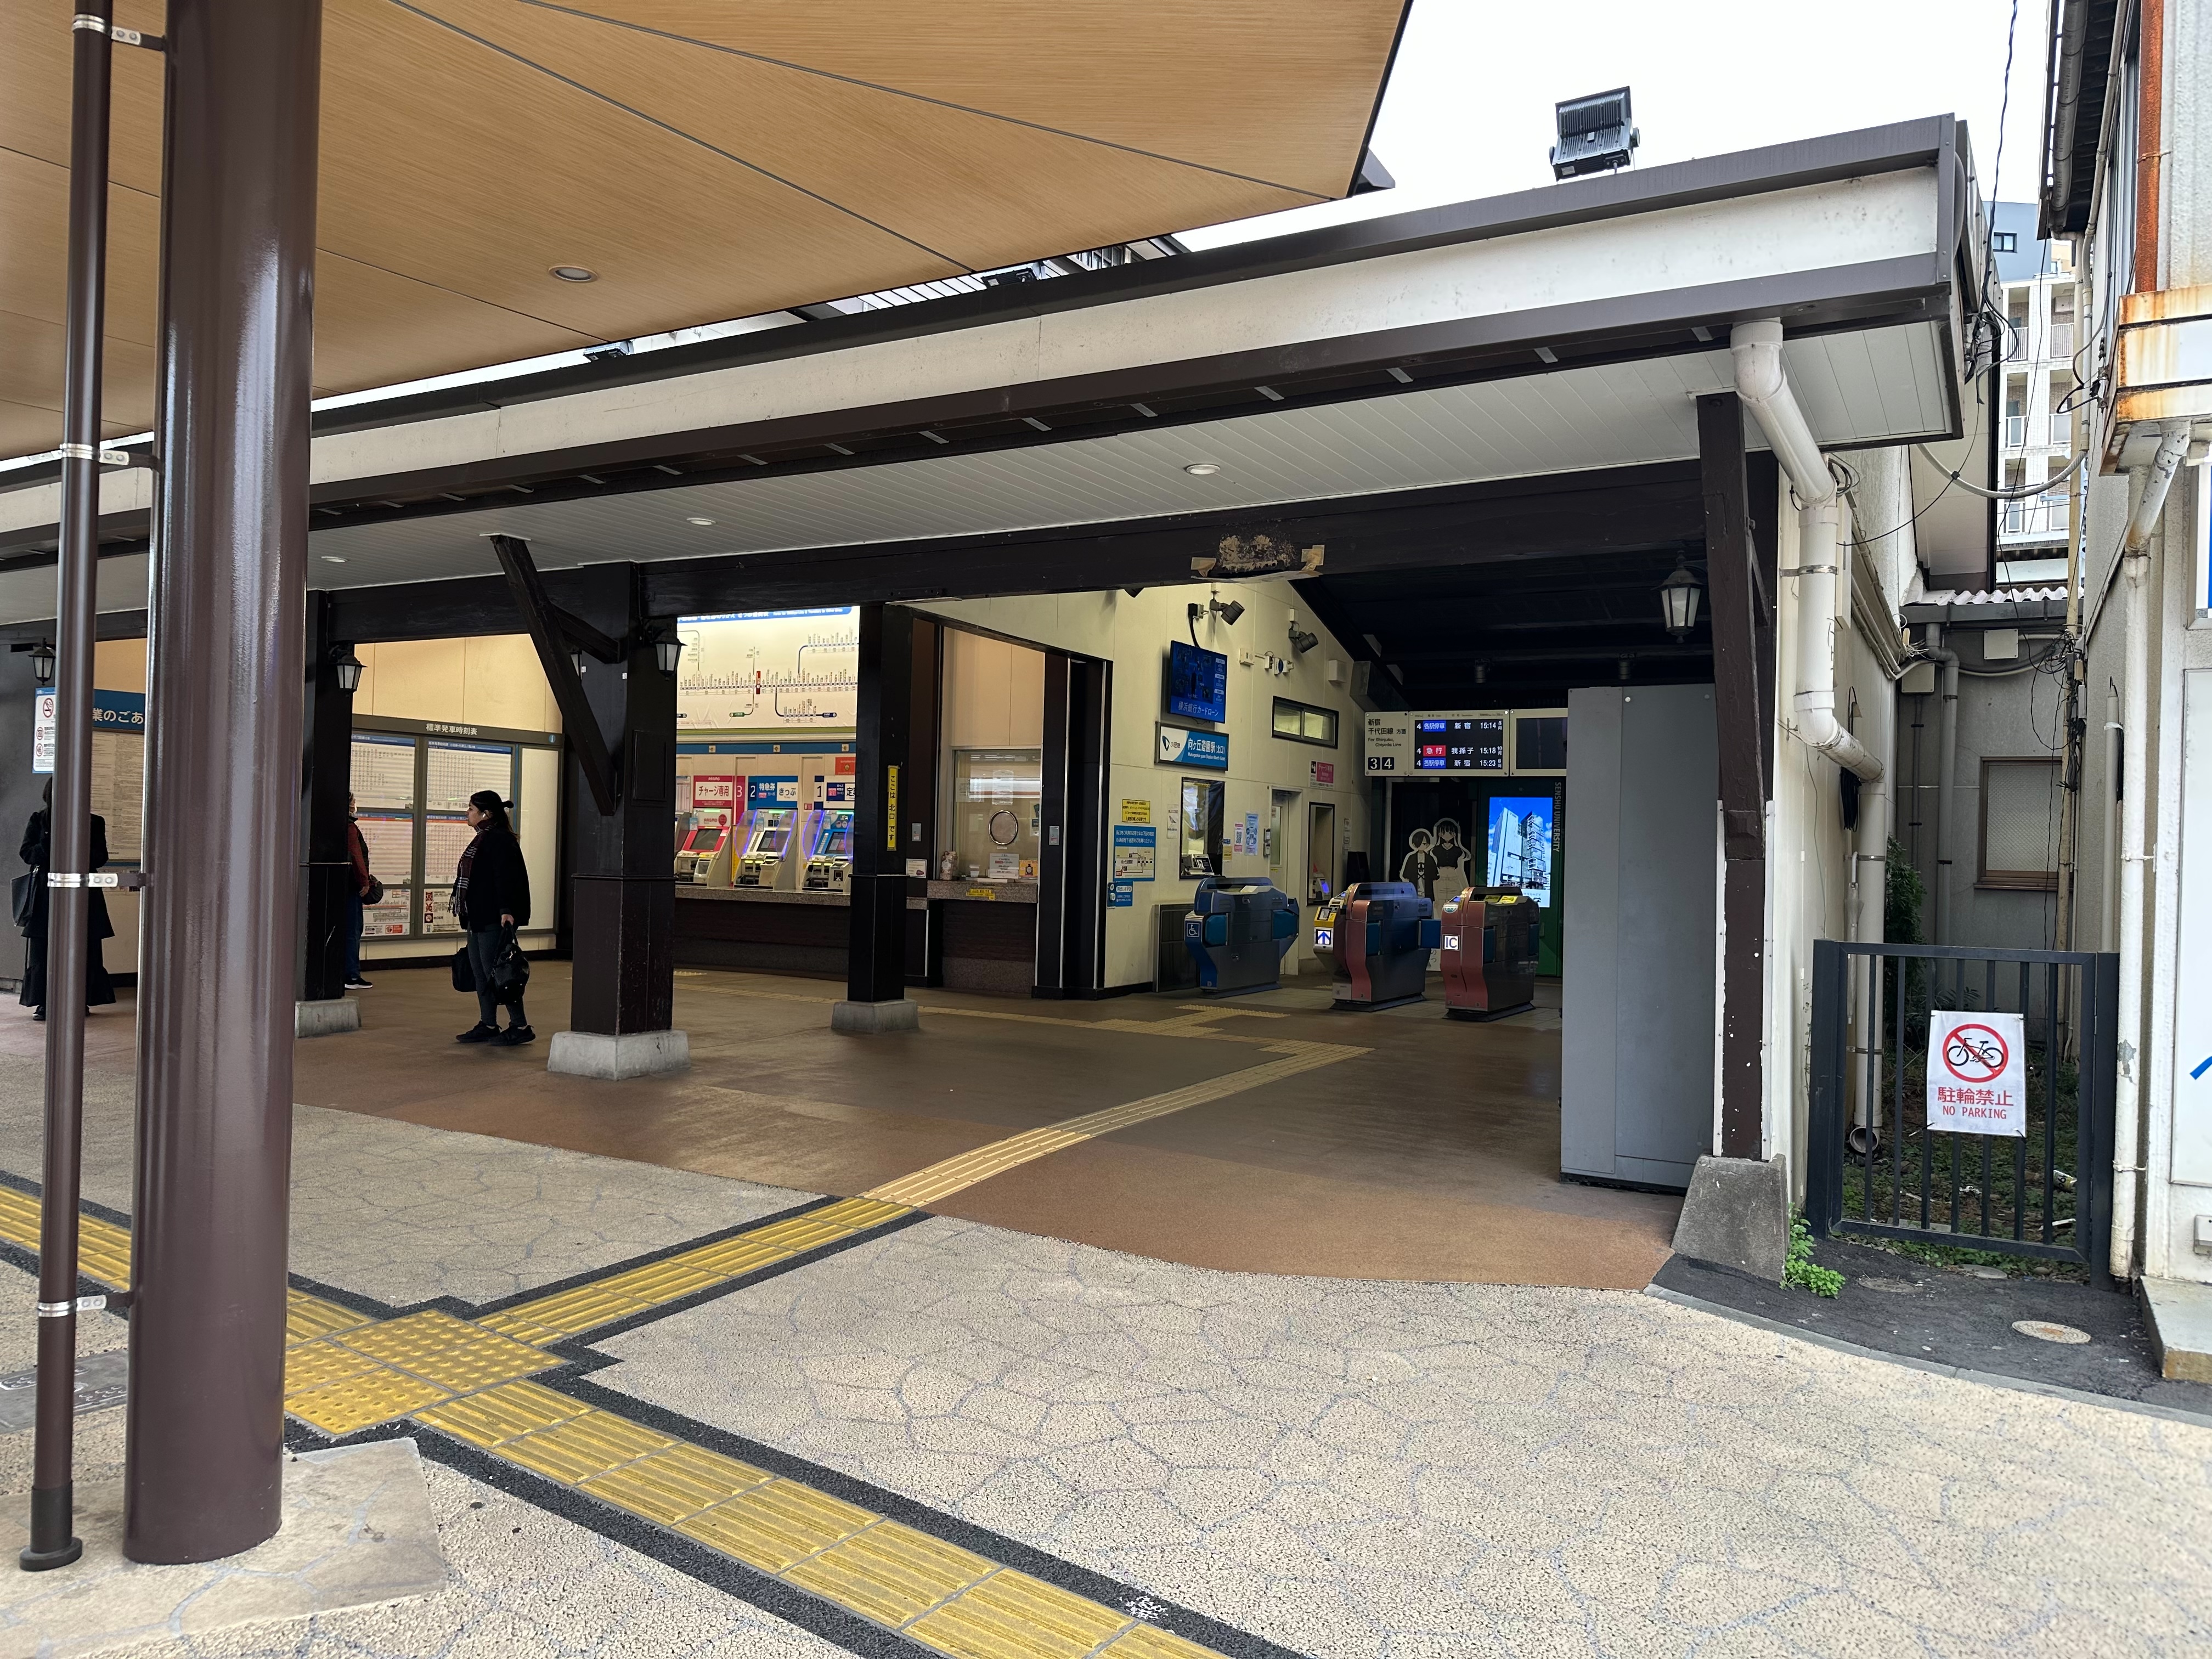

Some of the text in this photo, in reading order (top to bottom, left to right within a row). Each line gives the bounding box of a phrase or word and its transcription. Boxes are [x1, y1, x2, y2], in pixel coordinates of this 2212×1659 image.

[1178, 701, 1218, 716] 横浜銀行カードローン
[426, 723, 478, 736] 標準発車時刻表
[1370, 758, 1392, 769] 3 4
[698, 785, 729, 797] チャージ専用
[736, 785, 742, 798] 3
[750, 785, 755, 798] 2
[759, 782, 775, 791] 特急券
[779, 787, 796, 796] きっぷ
[817, 786, 822, 798] 1
[889, 804, 895, 820] 北口
[889, 826, 895, 840] です
[1446, 937, 1458, 949] IC
[1938, 1086, 2014, 1107] 駐輪禁止
[1943, 1105, 2007, 1120] NO PARKING
